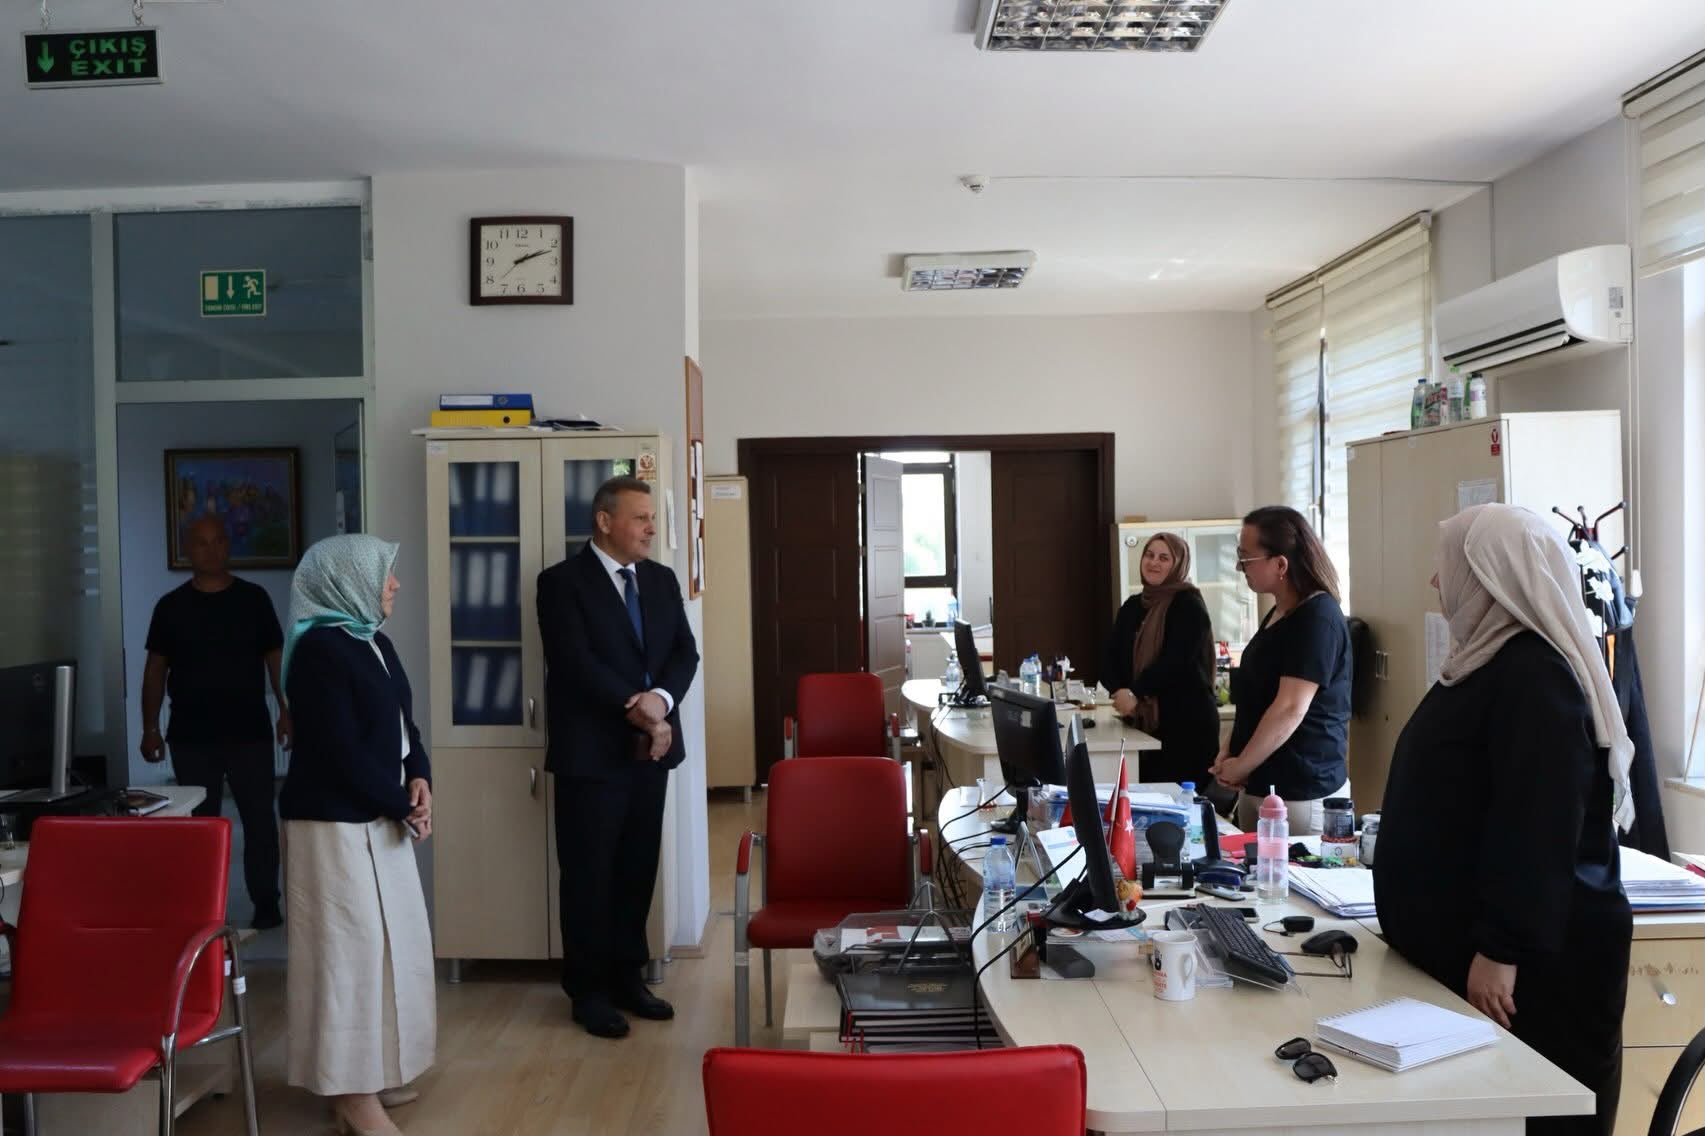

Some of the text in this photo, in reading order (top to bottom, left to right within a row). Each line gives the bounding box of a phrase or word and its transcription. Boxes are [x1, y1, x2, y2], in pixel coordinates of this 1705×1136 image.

[69, 36, 147, 59] ÇIKIŞ
[71, 59, 147, 75] EXIT
[500, 229, 509, 239] 11
[516, 229, 528, 239] 12
[486, 240, 499, 250] 10
[550, 239, 558, 248] 2
[486, 257, 495, 267] 9
[486, 275, 495, 285] 8
[501, 284, 508, 294] 7
[517, 284, 526, 293] 6
[537, 283, 545, 293] 5
